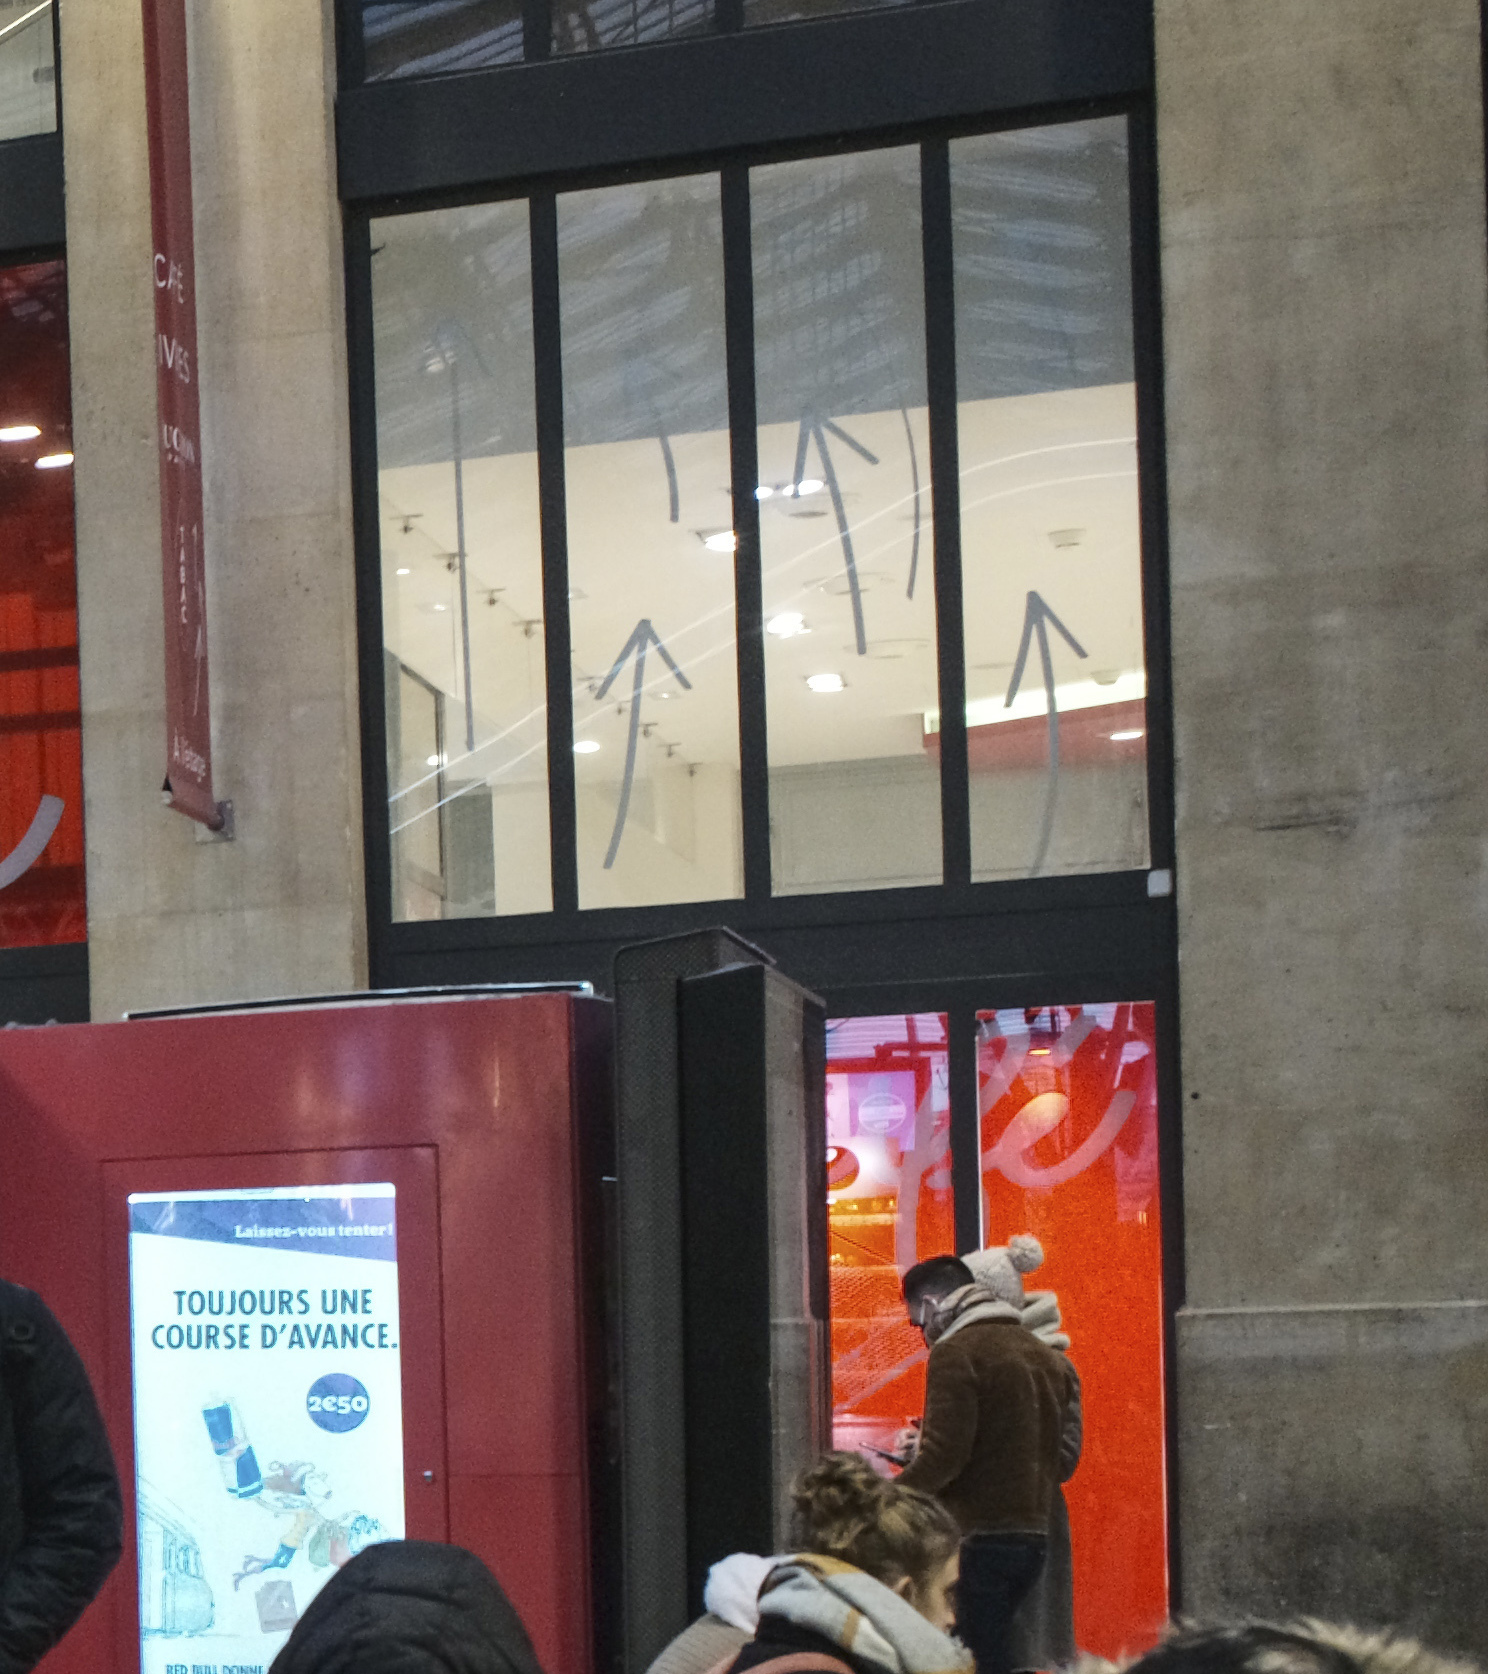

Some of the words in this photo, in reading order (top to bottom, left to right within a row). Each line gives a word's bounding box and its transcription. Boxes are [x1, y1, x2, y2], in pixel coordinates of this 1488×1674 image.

[234, 1223, 336, 1238] Laissez-vous
[173, 1288, 311, 1316] TOUJOURS
[320, 1288, 374, 1315] UNE
[150, 1323, 251, 1350] COURSE
[260, 1322, 399, 1350] D'AVANCE.
[307, 1395, 368, 1415] 2€50
